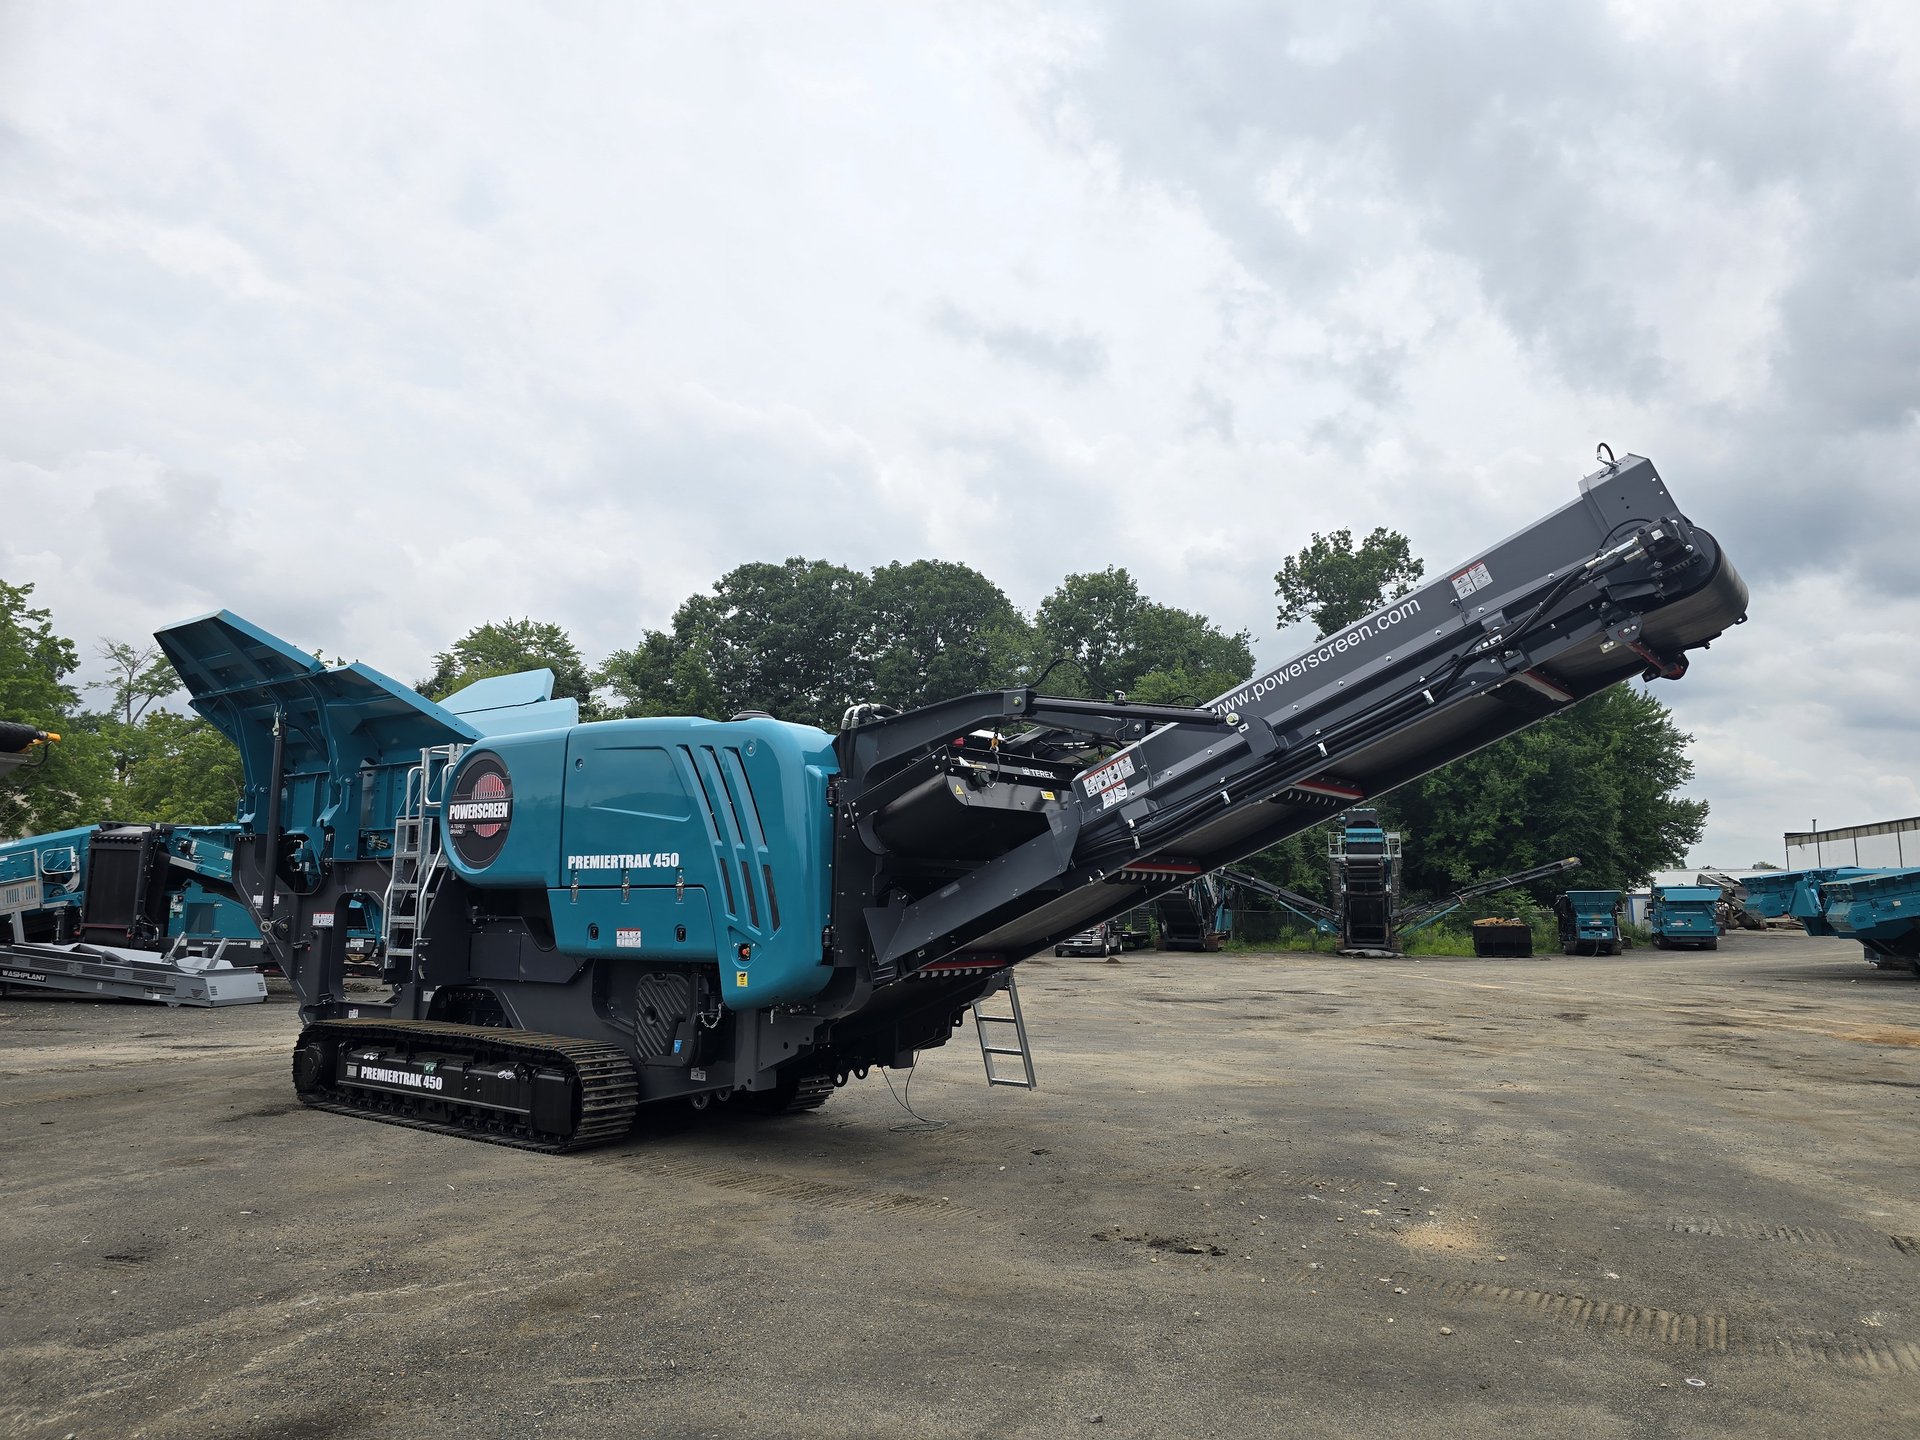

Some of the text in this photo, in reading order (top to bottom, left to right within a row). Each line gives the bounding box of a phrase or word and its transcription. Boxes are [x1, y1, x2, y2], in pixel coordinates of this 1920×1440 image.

[1030, 768, 1057, 780] TEREX
[449, 802, 509, 820] POWERSCREEN
[567, 852, 680, 870] PREMIERTRAK 450
[2, 969, 47, 981] WASHPLANT
[360, 1065, 423, 1088] PREMIERTRAK
[423, 1075, 443, 1091] 450
